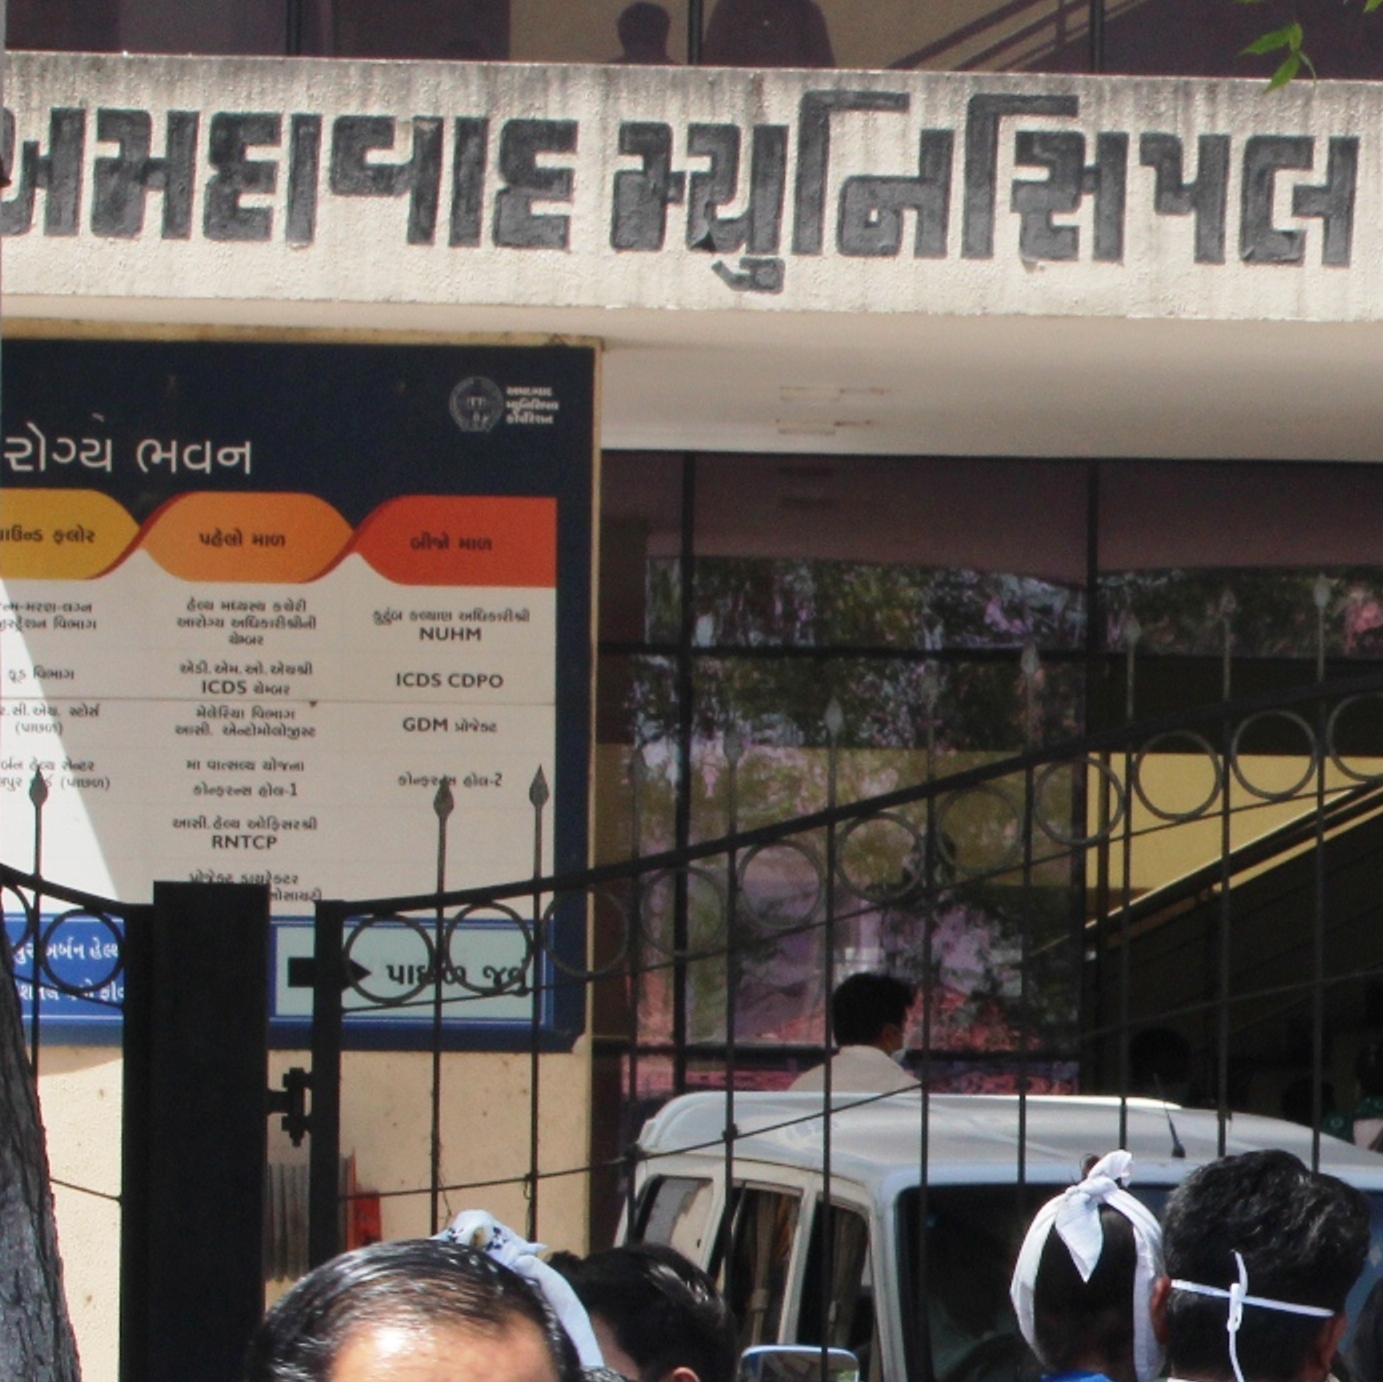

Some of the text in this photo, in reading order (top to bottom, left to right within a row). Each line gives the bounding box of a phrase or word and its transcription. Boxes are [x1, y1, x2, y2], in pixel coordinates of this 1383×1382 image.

[0, 104, 580, 250] અમદાવાદ
[608, 88, 1360, 292] મ્યુનિસિપલ
[136, 439, 251, 475] ભવન
[199, 528, 286, 547] પહેલો માળ
[411, 533, 493, 552] બીજો માળ
[177, 614, 224, 629] આરોગ્ય
[419, 627, 482, 641] NUHM
[202, 680, 247, 694] ICDS
[396, 672, 504, 688] ICDS CDPO
[251, 706, 296, 719] વિભાગ
[402, 716, 449, 732] GDM
[211, 834, 277, 850] RNTCP
